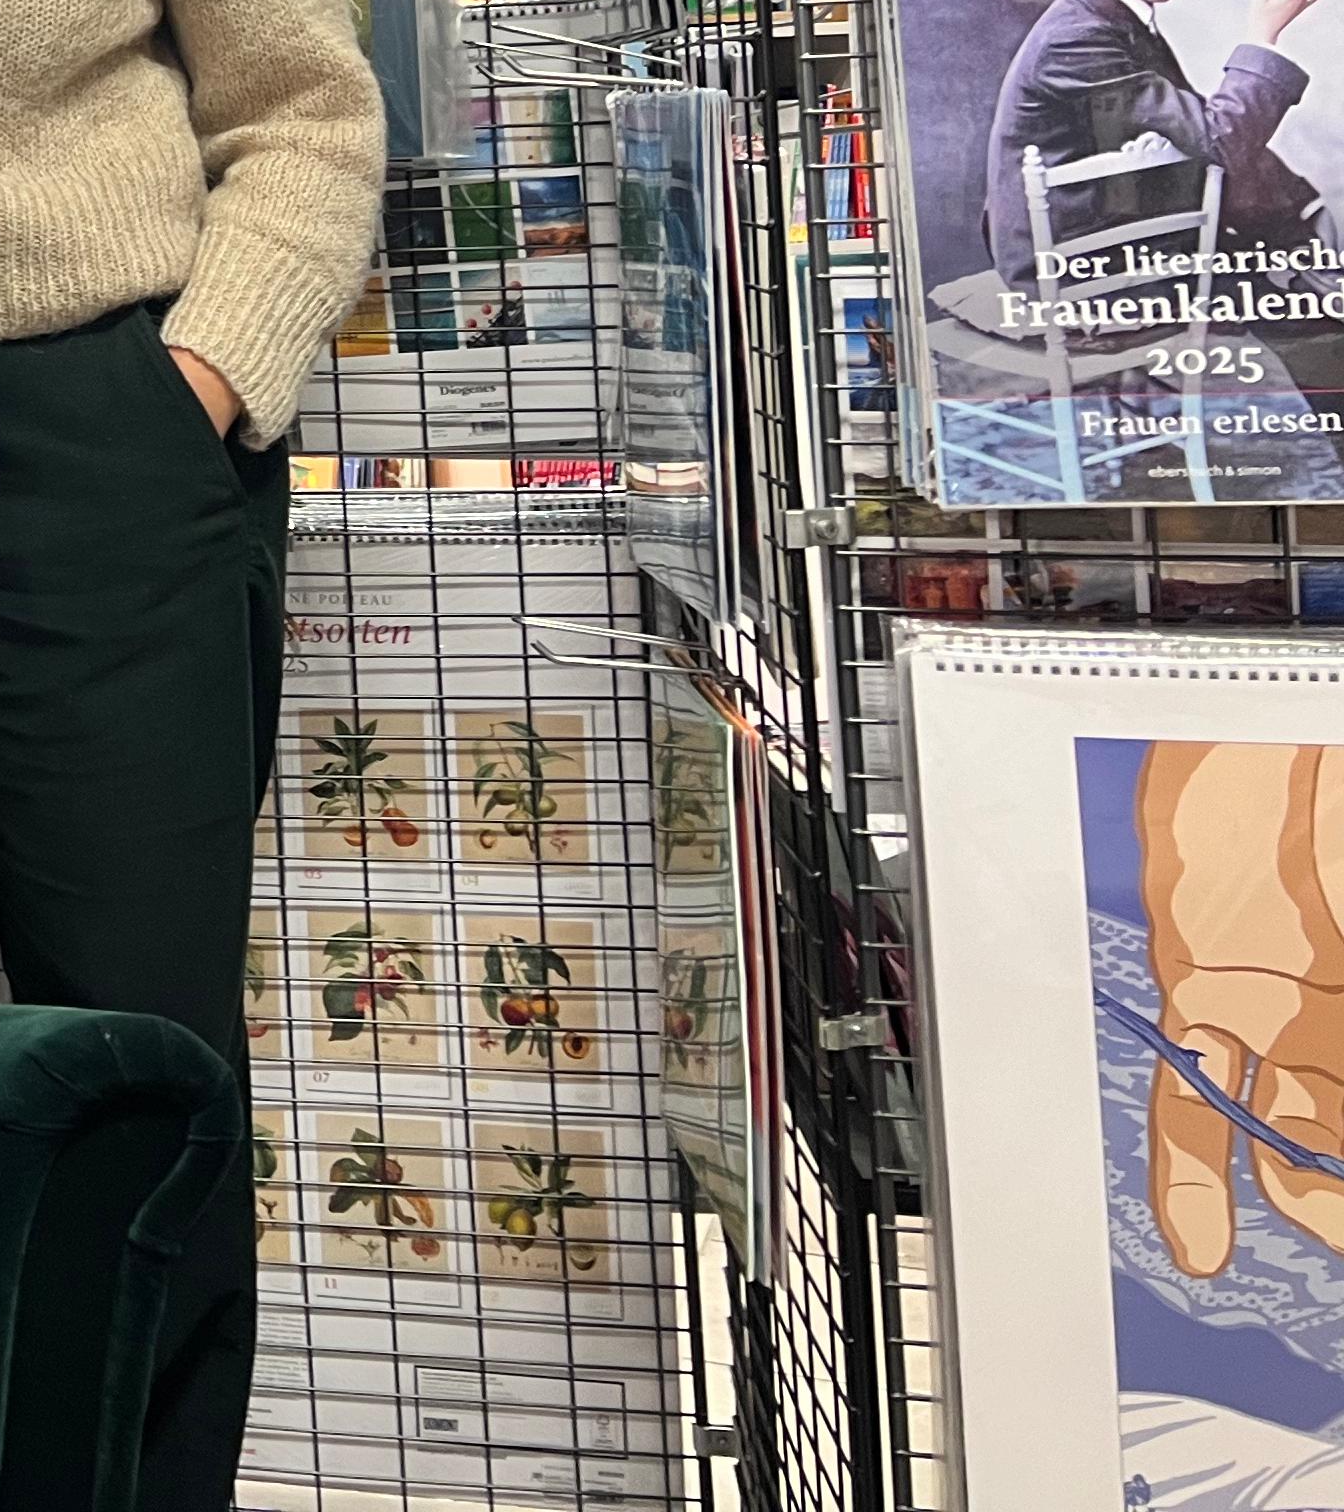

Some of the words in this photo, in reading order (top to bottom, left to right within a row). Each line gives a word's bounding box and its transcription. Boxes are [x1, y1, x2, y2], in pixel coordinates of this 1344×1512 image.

[1035, 250, 1111, 280] Der
[1123, 239, 1344, 277] literarisch
[997, 279, 1344, 328] Frauenkalend
[1146, 346, 1264, 383] 2025
[440, 384, 496, 396] Diogenes
[1081, 410, 1202, 438] Frauen
[1213, 405, 1343, 434] erlesen
[318, 593, 392, 606] POIEAU
[284, 618, 411, 644] stsoten
